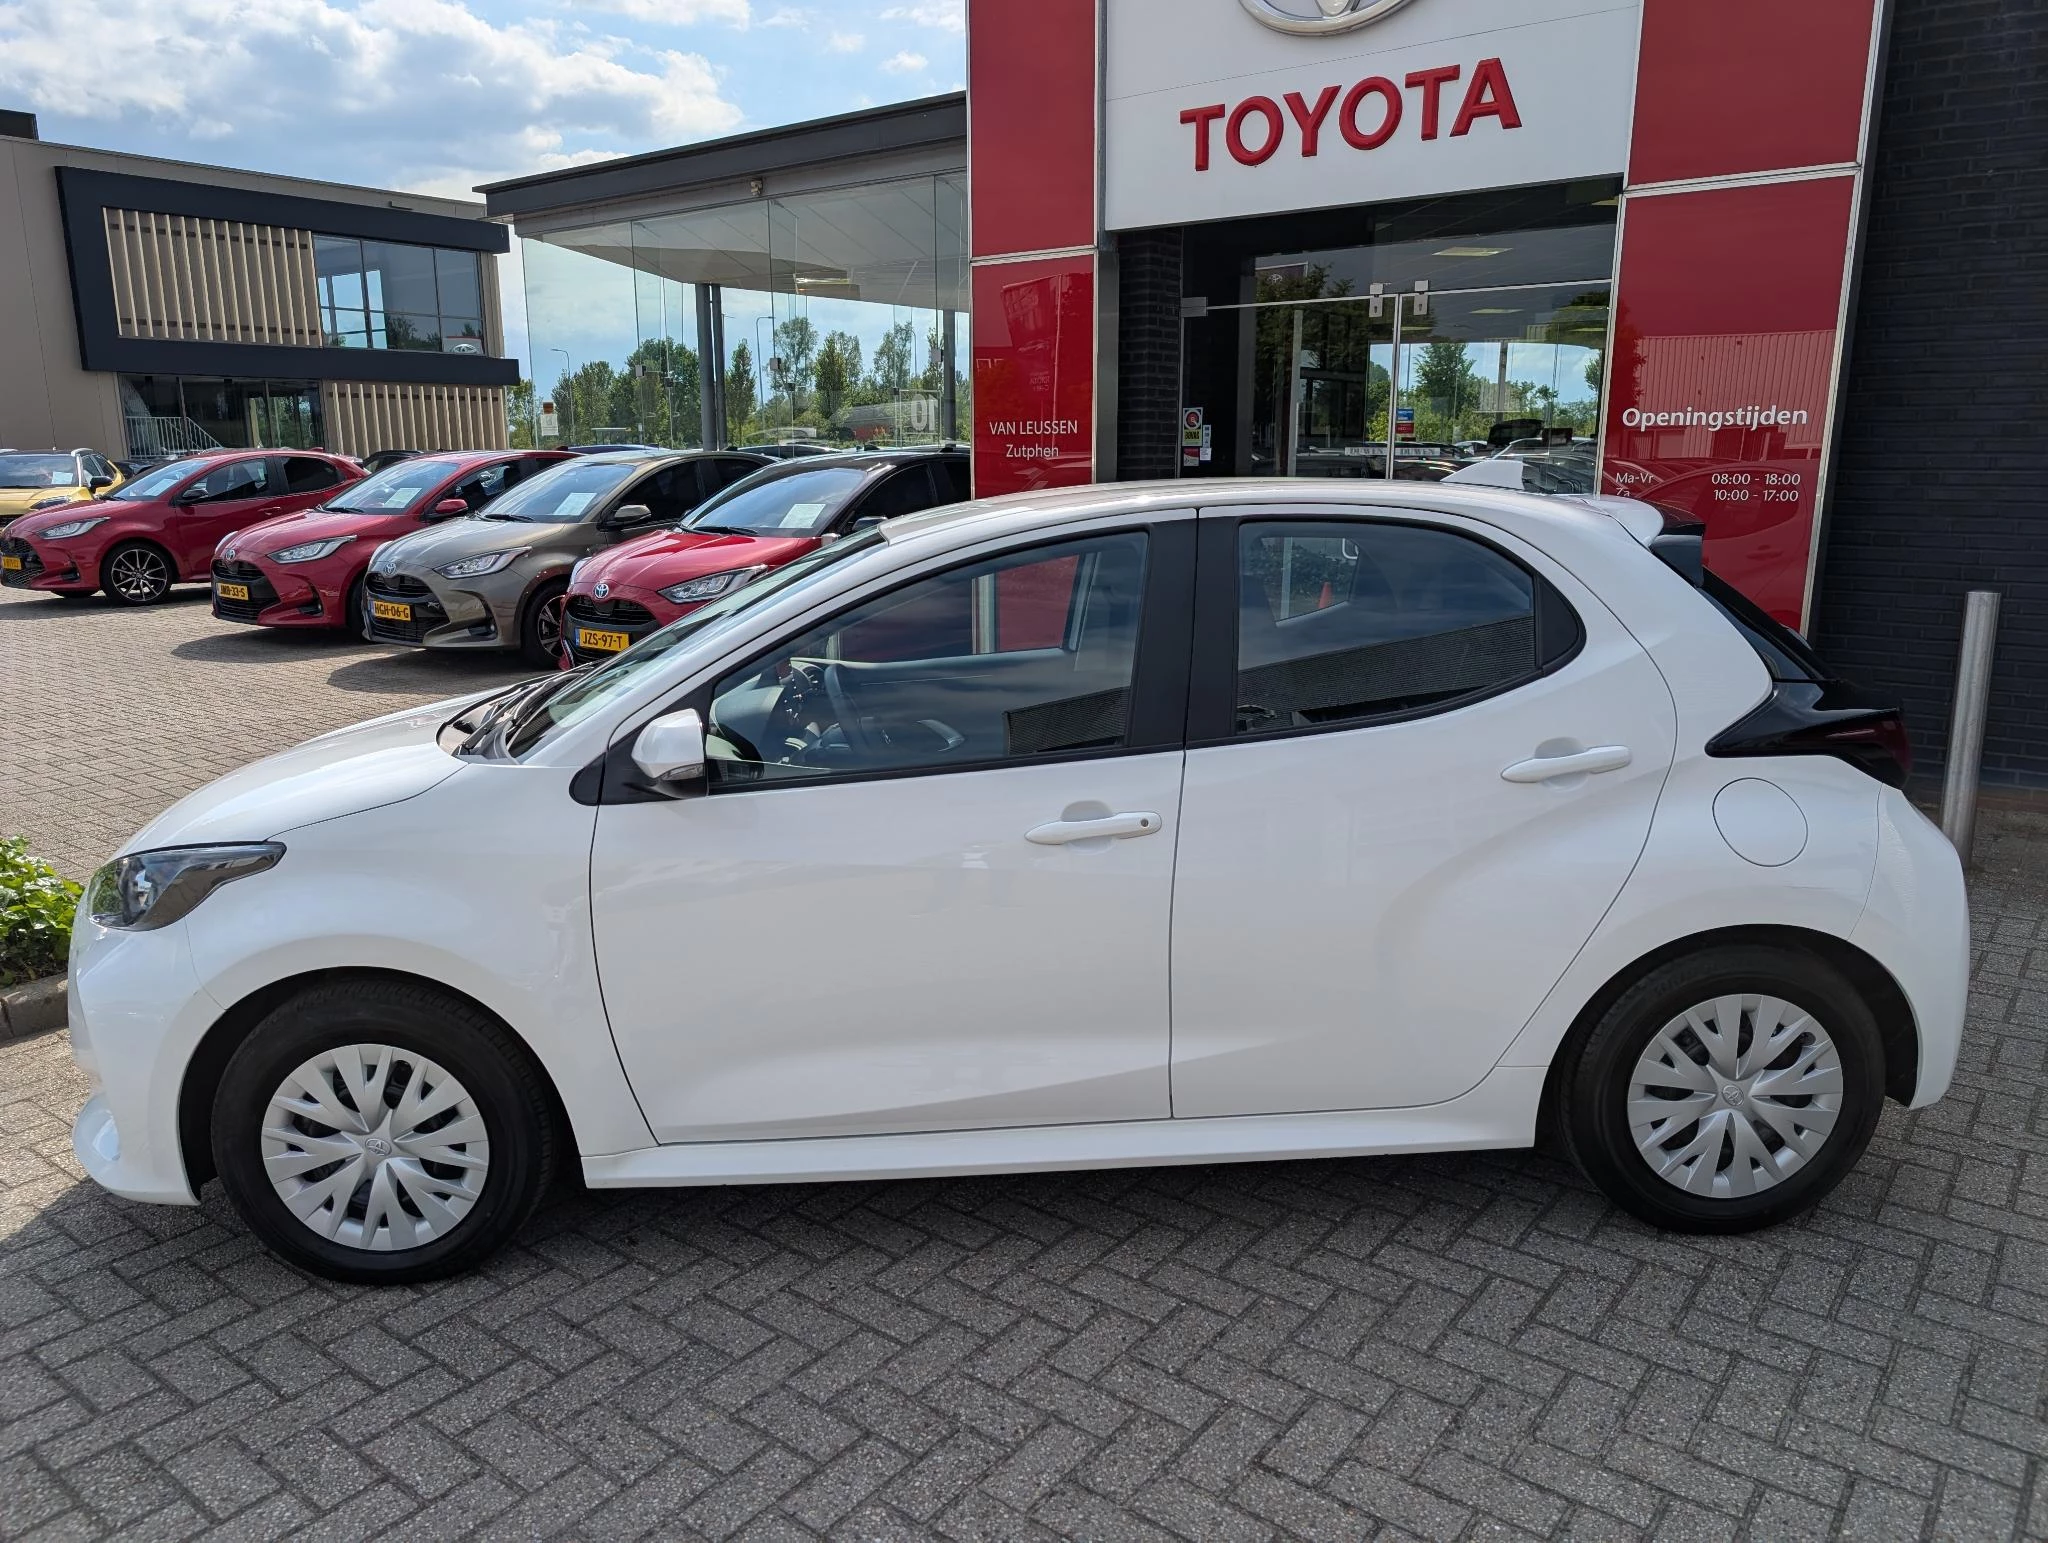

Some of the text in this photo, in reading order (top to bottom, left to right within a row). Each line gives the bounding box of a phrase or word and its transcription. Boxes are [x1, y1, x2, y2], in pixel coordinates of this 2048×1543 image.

[1180, 57, 1523, 172] TOYOTA
[1622, 404, 1808, 432] Openingstijden
[989, 420, 1078, 435] VAN LEUSSEN
[1006, 443, 1059, 461] Zutphen
[1615, 472, 1654, 484] Ma-Vr
[1711, 473, 1751, 485] 08:00
[1765, 473, 1801, 485] 18:00
[1714, 489, 1749, 501] 10:00
[1763, 489, 1799, 502] 17:00
[582, 631, 623, 649] JZS-97-T
